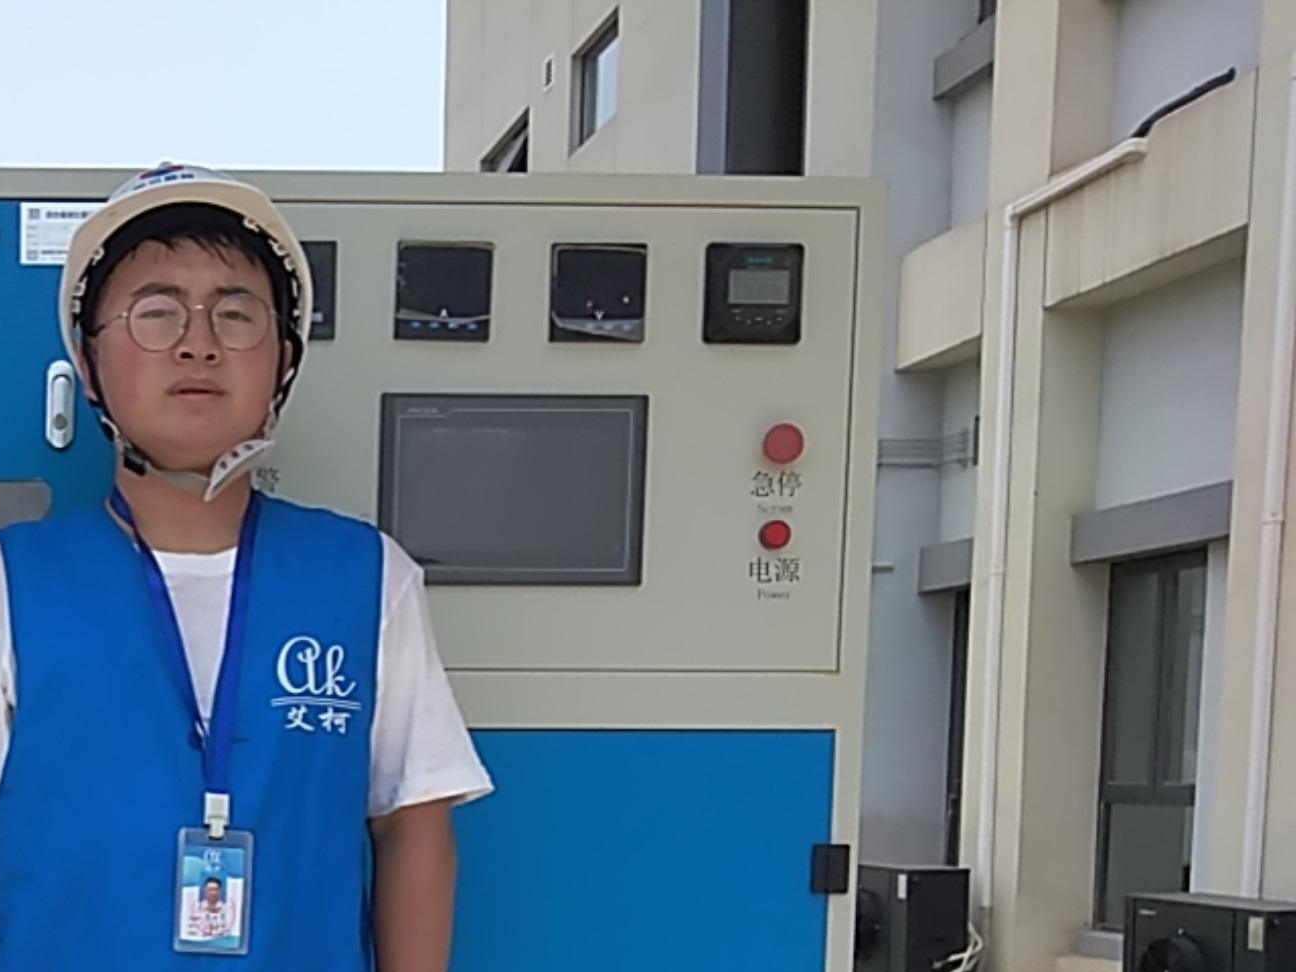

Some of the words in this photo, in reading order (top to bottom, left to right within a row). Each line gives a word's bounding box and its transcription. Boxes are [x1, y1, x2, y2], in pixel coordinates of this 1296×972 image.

[749, 470, 802, 498] 急停
[749, 556, 800, 583] 电源
[284, 704, 352, 735] 艾柯
